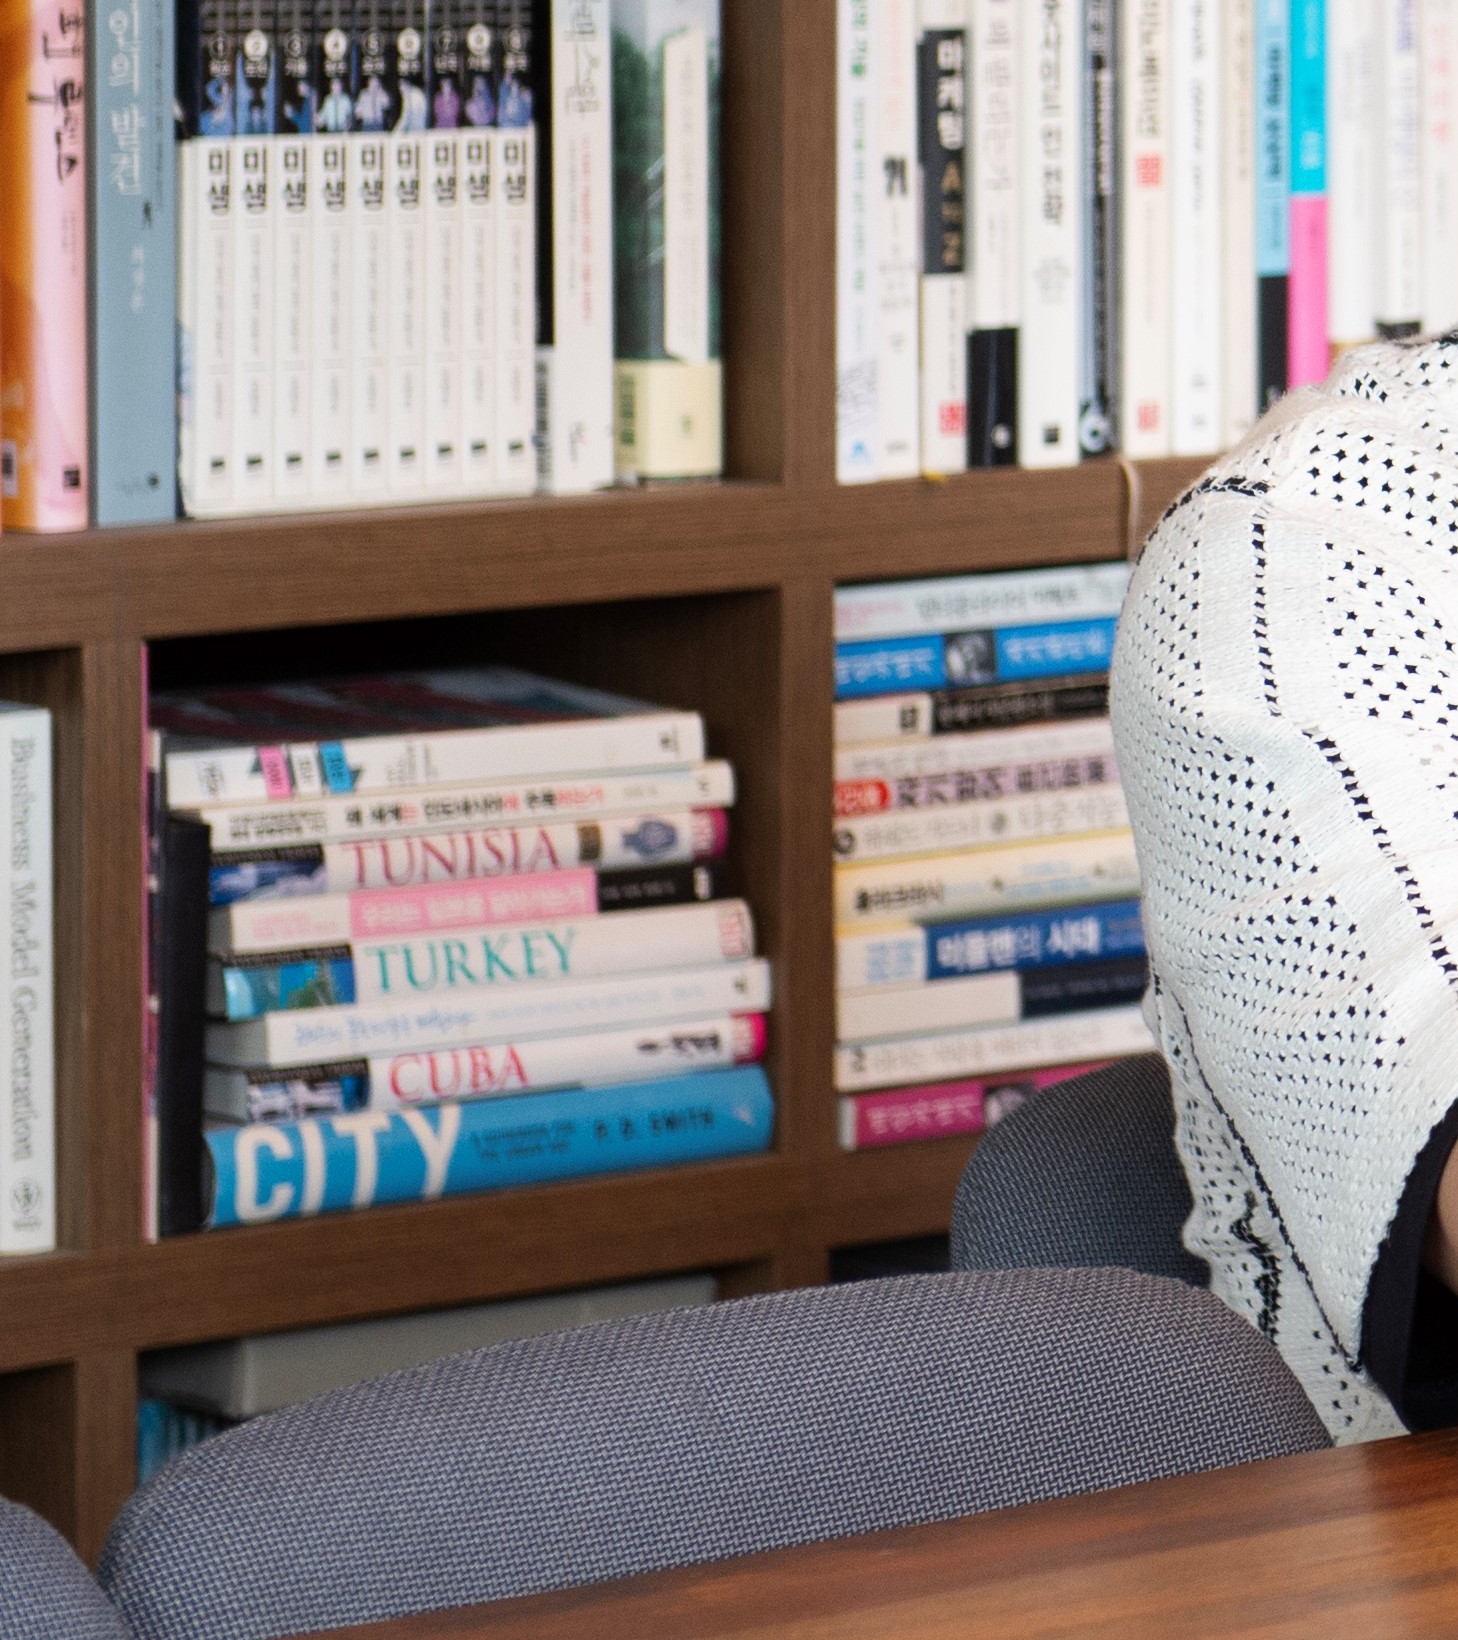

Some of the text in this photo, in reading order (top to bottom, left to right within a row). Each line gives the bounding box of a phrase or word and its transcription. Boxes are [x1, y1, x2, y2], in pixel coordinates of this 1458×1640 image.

[208, 148, 230, 216] 미생
[244, 147, 267, 214] 미생
[284, 146, 306, 214] 미생
[324, 145, 347, 213] 미생
[361, 144, 384, 211] 미생
[397, 143, 420, 210] 미생
[435, 143, 457, 206] 미생
[468, 141, 491, 204] 미생
[504, 141, 527, 205] 미생
[338, 823, 562, 890] TUNISIA
[9, 736, 38, 1161] Business Model Generation
[363, 927, 578, 993] TURKEY
[934, 917, 1103, 970] 미들맨의 시대
[388, 1042, 530, 1103] CUBA
[650, 1107, 715, 1135] SMITH
[234, 1104, 463, 1225] CITY
